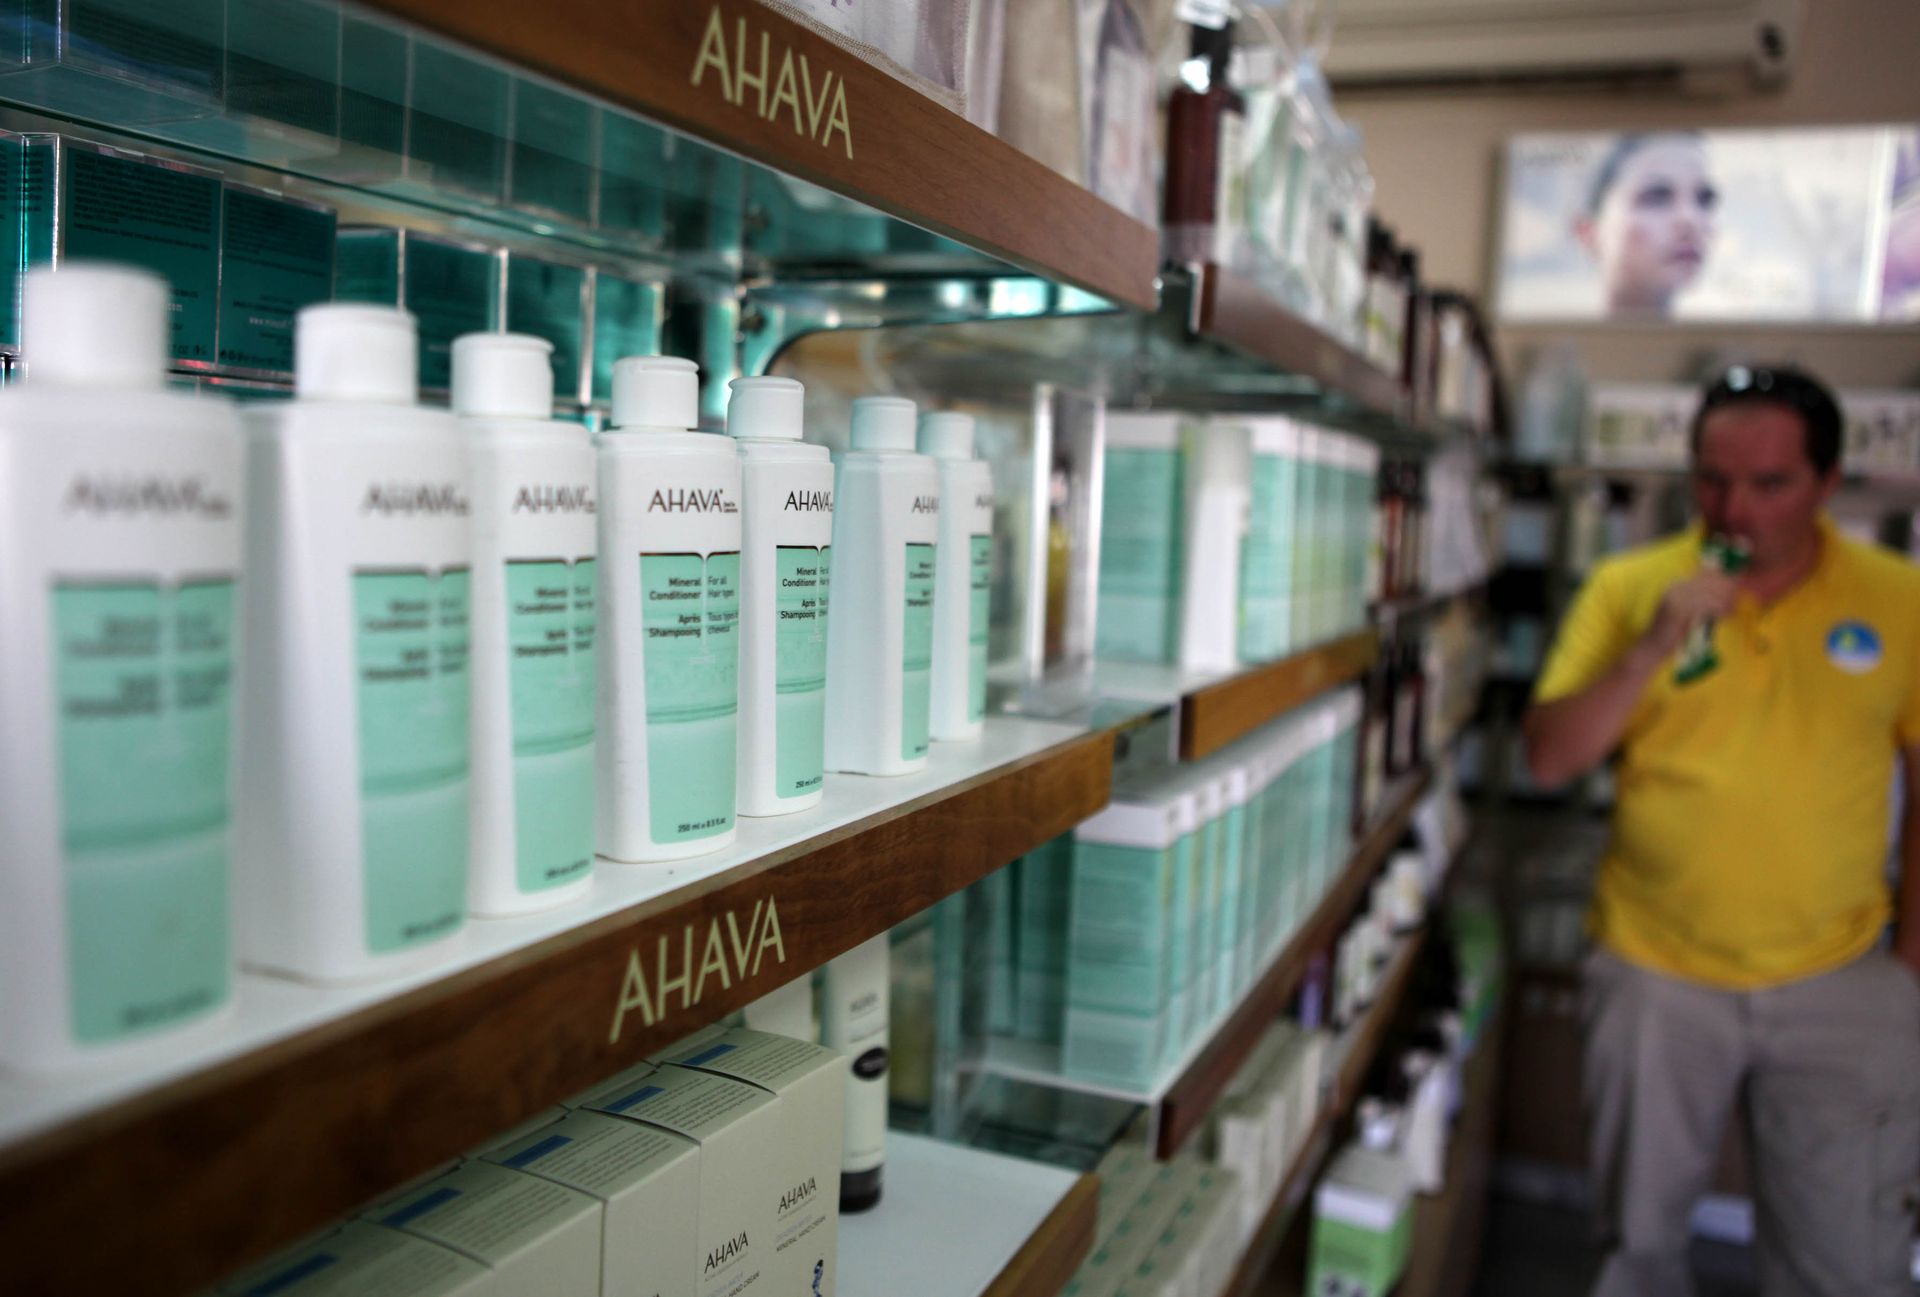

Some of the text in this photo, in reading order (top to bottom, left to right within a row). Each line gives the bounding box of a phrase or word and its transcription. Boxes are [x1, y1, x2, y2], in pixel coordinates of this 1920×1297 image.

[690, 3, 853, 160] AHAVA
[647, 488, 723, 513] AHAVA
[784, 490, 830, 512] AHAVA
[796, 567, 818, 576] Mineral
[668, 577, 702, 587] Mineral
[782, 578, 818, 587] Conditioner
[648, 589, 702, 601] Conditioner
[780, 610, 816, 620] Shampooing
[648, 627, 702, 639] Shampooing
[677, 823, 690, 833] 250
[609, 893, 786, 1044] AHAVA
[777, 1176, 817, 1215] AHAVA
[703, 1230, 749, 1275] AHAVA
